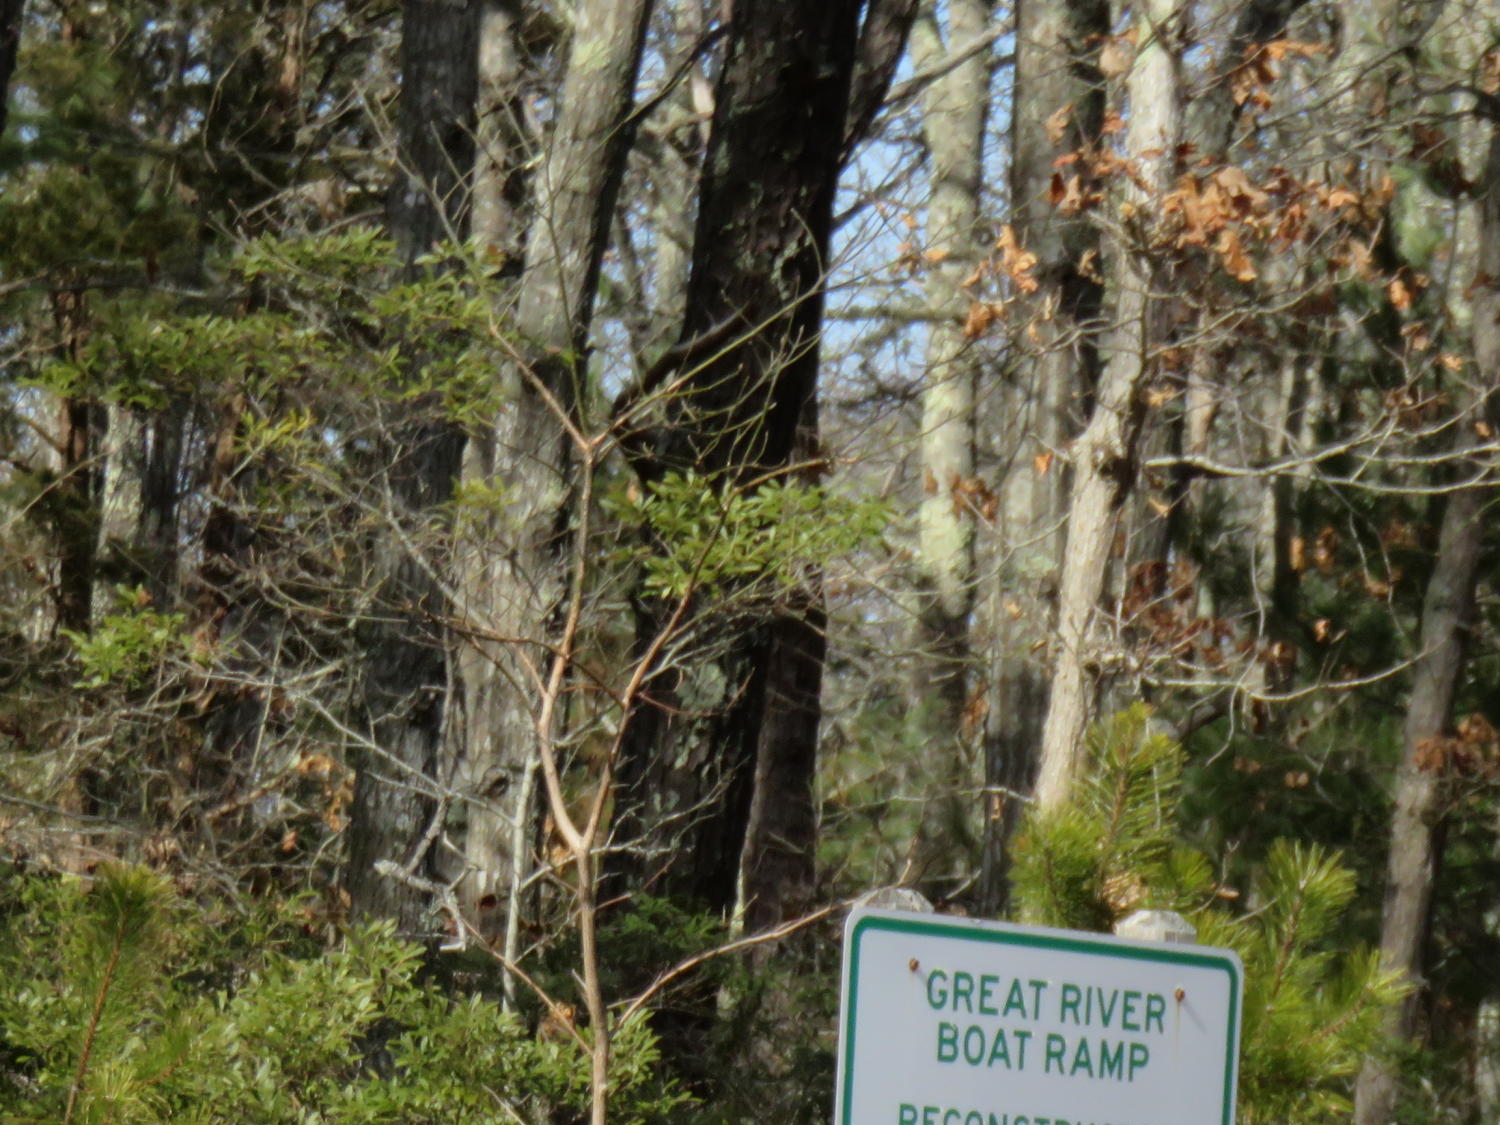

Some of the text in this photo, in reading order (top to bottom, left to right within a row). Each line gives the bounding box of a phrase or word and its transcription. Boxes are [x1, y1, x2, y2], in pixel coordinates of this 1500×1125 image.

[927, 969, 1166, 1034] GREAT RIVER
[937, 1022, 1150, 1081] BOAT RAMP
